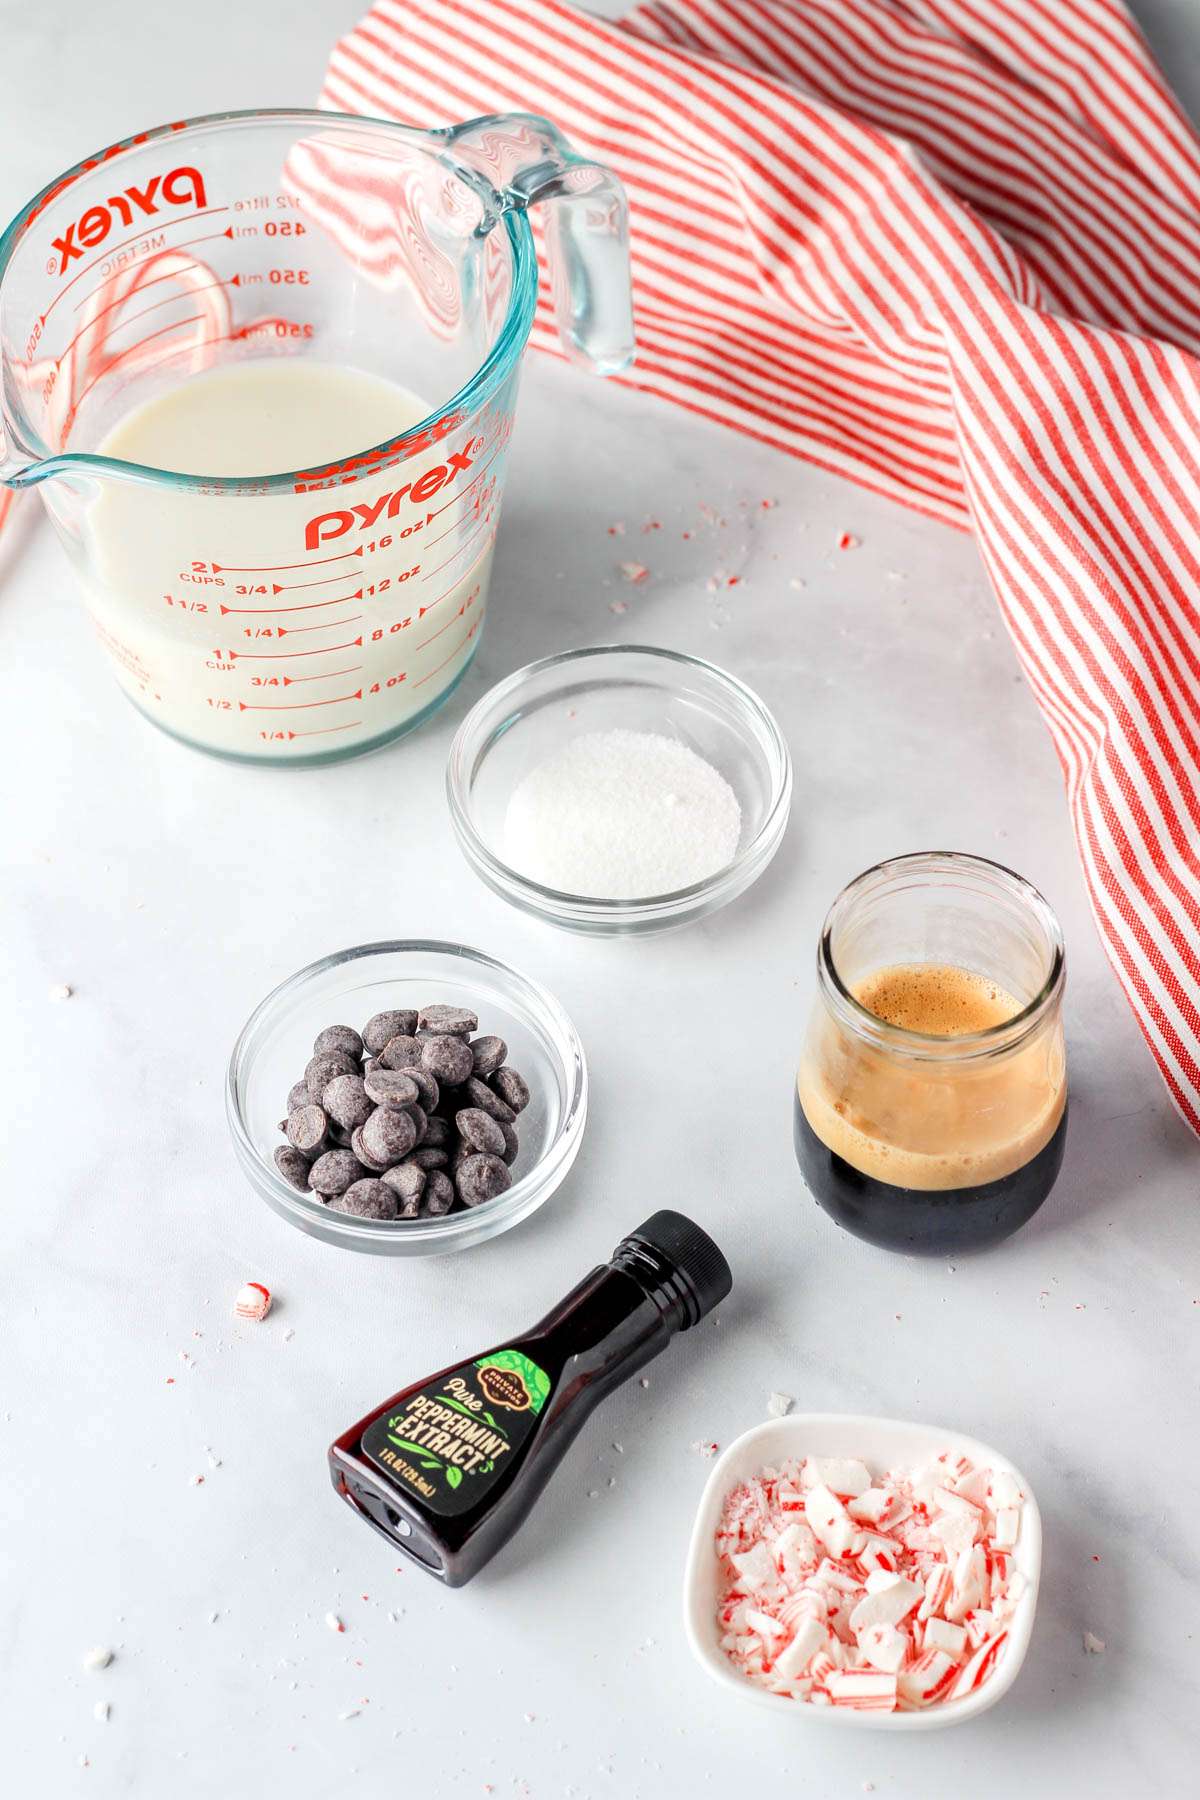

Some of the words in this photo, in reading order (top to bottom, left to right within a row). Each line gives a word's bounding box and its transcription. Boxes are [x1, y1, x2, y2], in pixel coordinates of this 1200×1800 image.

[367, 535, 392, 552] 16
[400, 520, 424, 539] oz
[191, 562, 207, 573] 2
[179, 573, 225, 587] CUPS
[367, 579, 391, 595] 12
[398, 565, 421, 582] oz
[235, 585, 268, 595] 3/4
[244, 628, 273, 638] 1/4
[371, 629, 383, 641] 8
[390, 617, 412, 633] oz
[213, 649, 222, 659] 1
[206, 660, 236, 671] CUP
[251, 677, 279, 686] 3/4
[369, 683, 380, 694] 4
[386, 673, 408, 687] oz
[206, 698, 232, 710] 1/2
[260, 731, 285, 740] 1/4
[490, 1371, 524, 1399] PRIVATE
[443, 1378, 483, 1411] Pure
[406, 1395, 511, 1459] PEPPERMINT
[395, 1415, 485, 1471] EXTRACT
[379, 1448, 388, 1457] 1
[383, 1451, 397, 1464] FL
[392, 1459, 407, 1472] OZ
